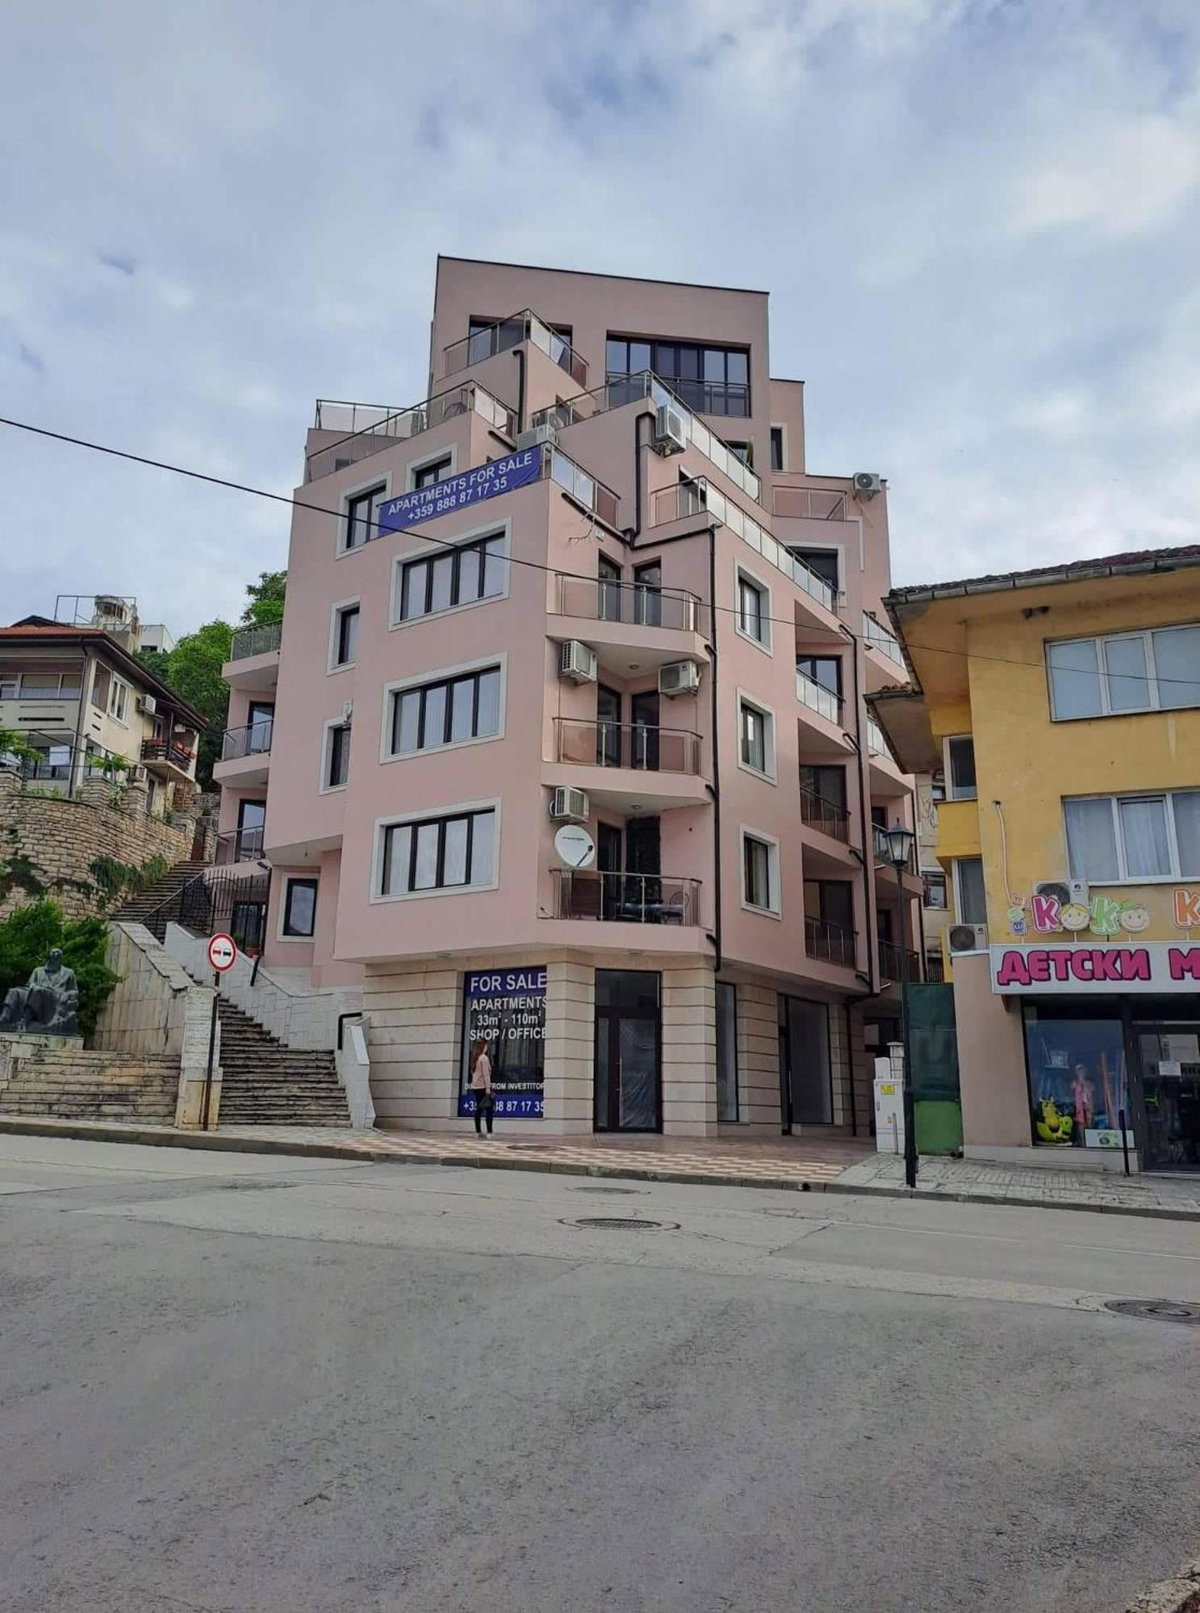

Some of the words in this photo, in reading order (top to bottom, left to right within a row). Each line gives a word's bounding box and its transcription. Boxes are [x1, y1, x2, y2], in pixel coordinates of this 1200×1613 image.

[388, 478, 467, 516] APARTMENTS
[469, 466, 496, 486] FOR
[498, 452, 533, 475] SALE
[407, 503, 434, 521] +359
[436, 494, 457, 512] 888
[459, 488, 473, 504] 87
[476, 483, 491, 497] 17
[493, 476, 508, 492] 35
[997, 949, 1151, 986] ДЕТСКИ
[470, 976, 502, 993] FOR
[506, 972, 547, 990] SALE
[470, 1029, 500, 1041] SHOP
[506, 1101, 518, 1111] 87
[520, 1101, 532, 1112] 17
